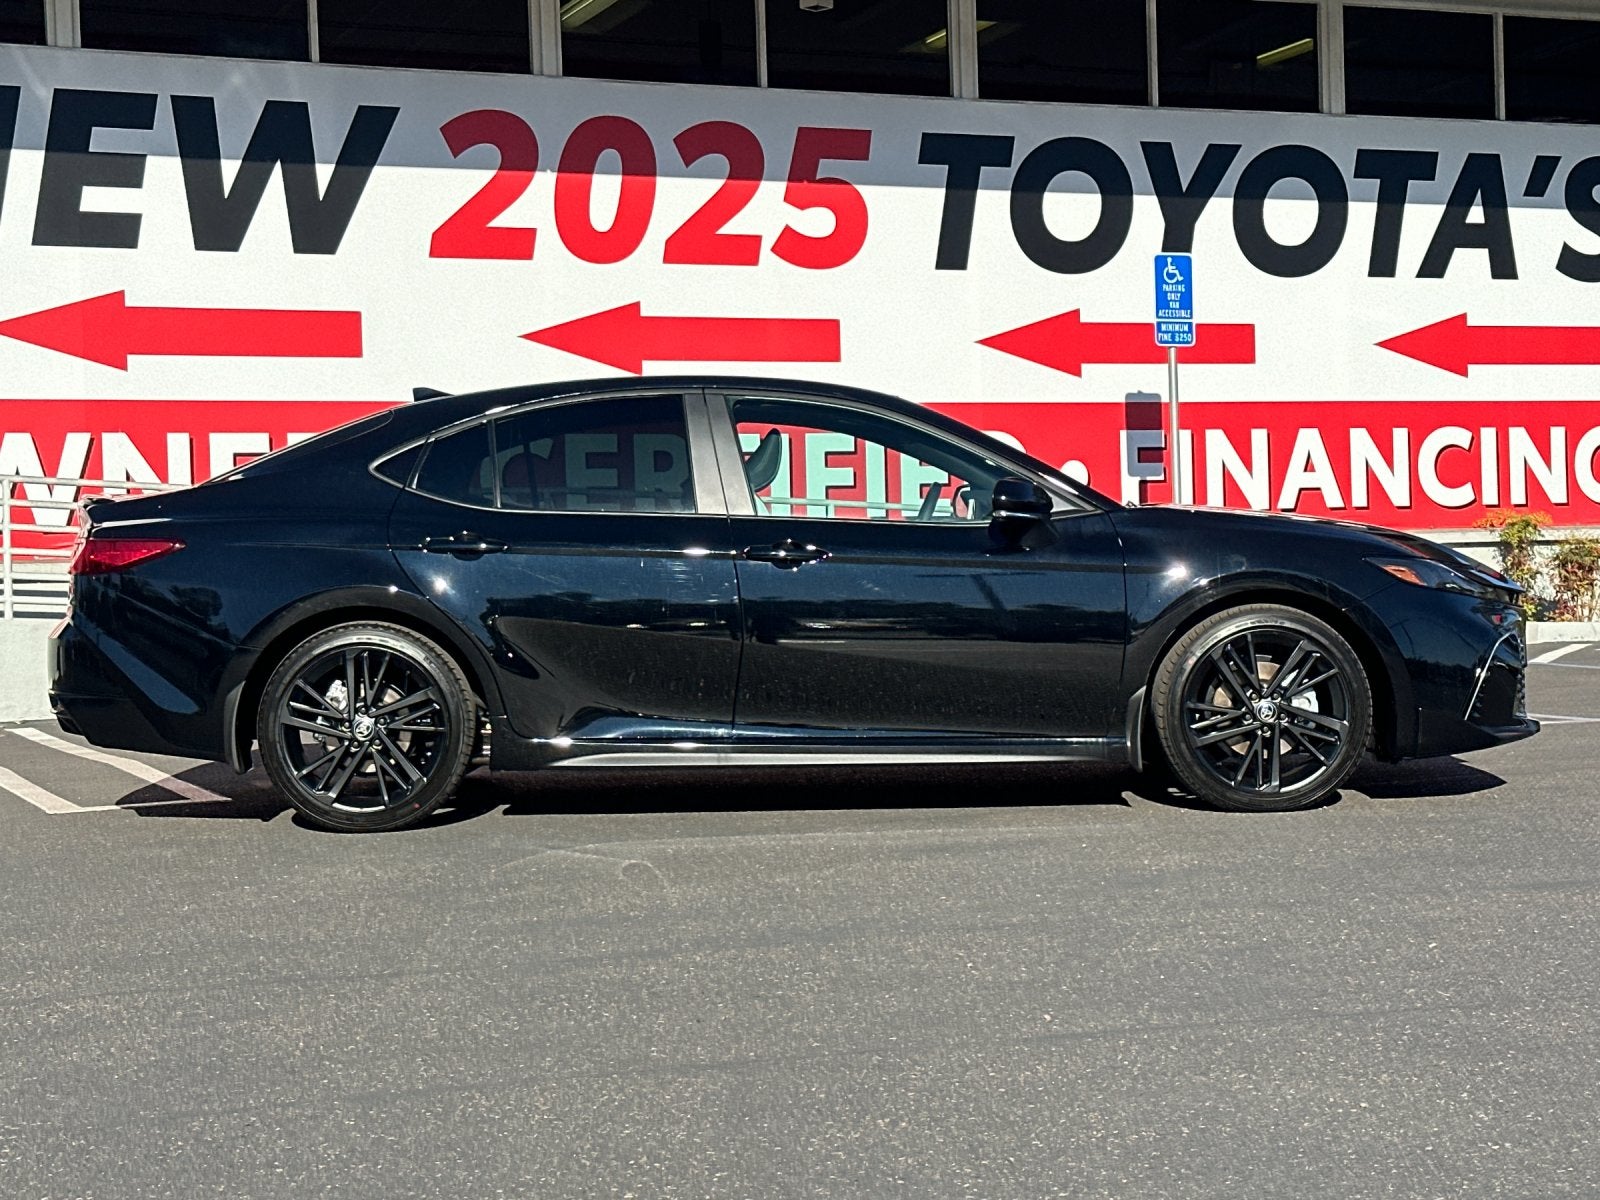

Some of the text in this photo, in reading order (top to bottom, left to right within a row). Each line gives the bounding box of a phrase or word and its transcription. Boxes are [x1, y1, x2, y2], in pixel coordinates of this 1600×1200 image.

[0, 86, 400, 255] EW
[429, 109, 871, 269] 2025
[1162, 284, 1186, 293] PARKING
[1167, 292, 1181, 301] ONLY
[1169, 301, 1180, 309] VAN
[1158, 309, 1191, 318] ACCESSIBLE
[1161, 323, 1189, 332] MINIMUM
[1158, 333, 1192, 342] FINE $250
